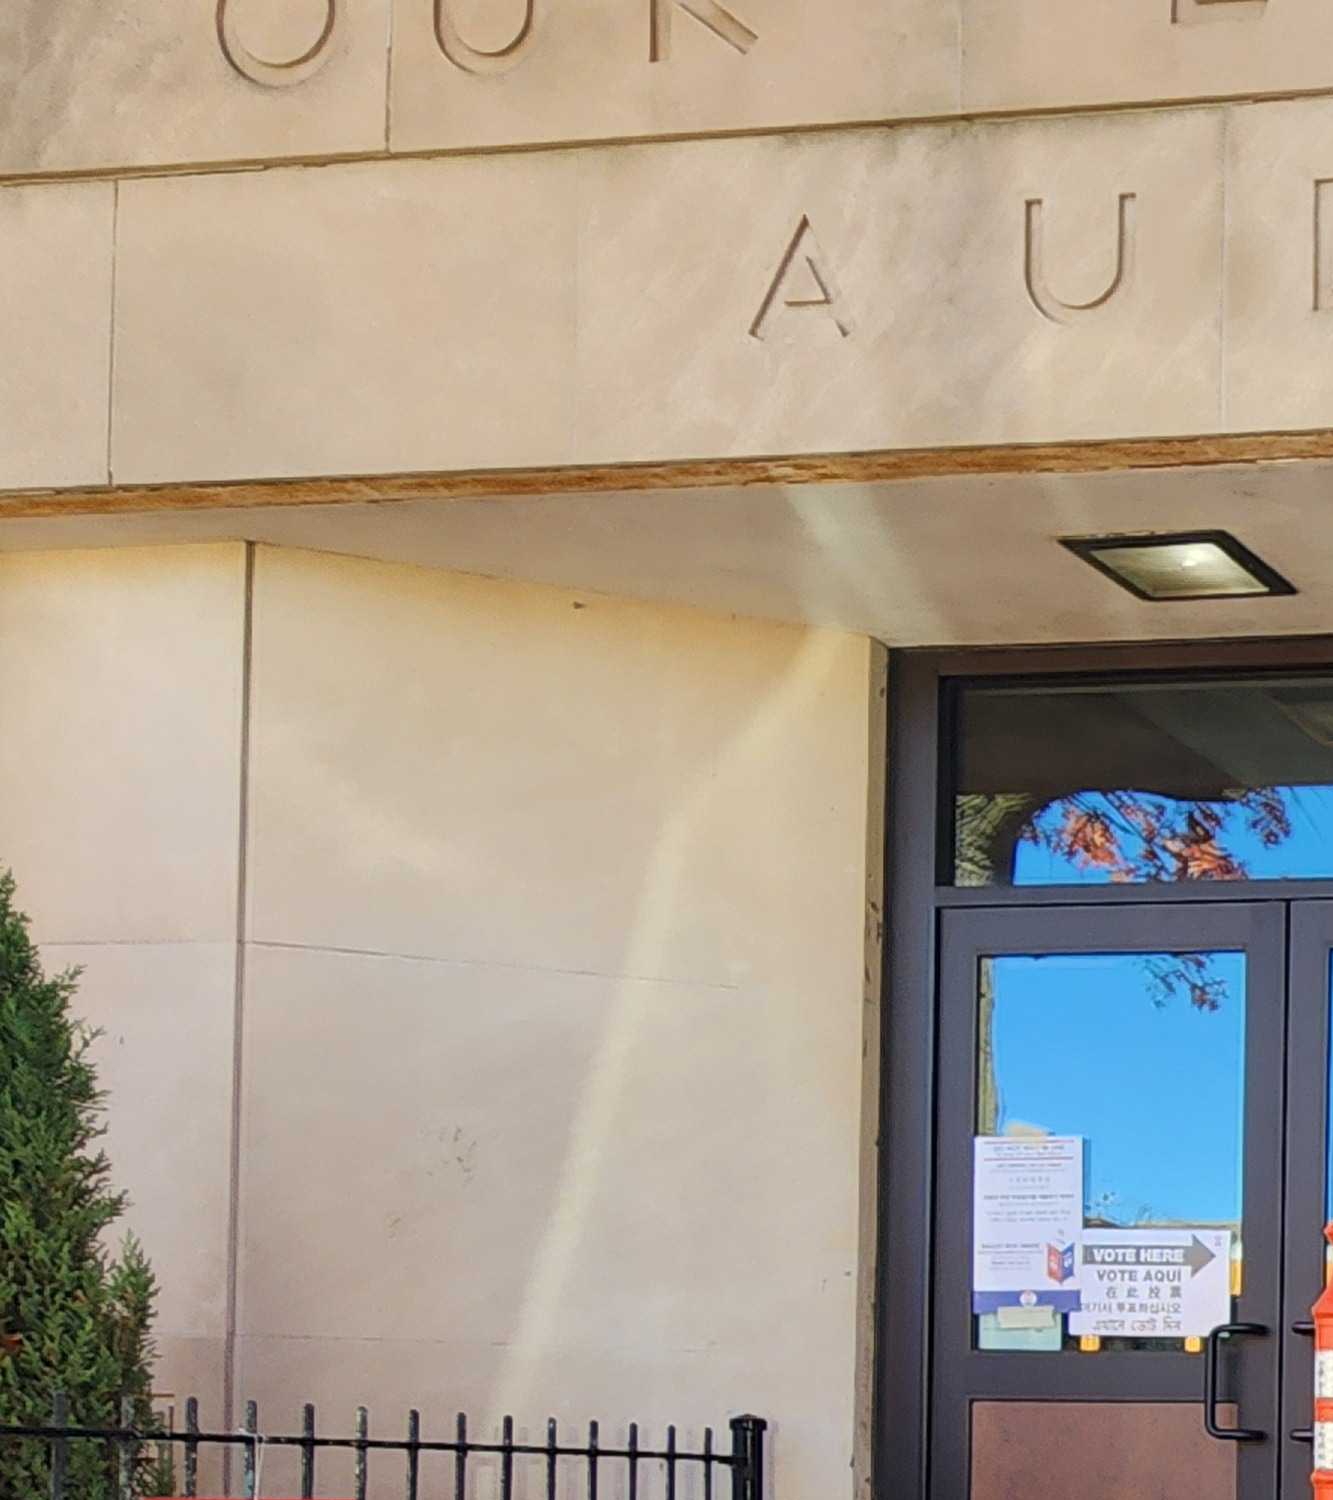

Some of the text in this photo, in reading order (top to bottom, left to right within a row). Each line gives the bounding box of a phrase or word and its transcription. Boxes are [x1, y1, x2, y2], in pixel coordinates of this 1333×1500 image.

[1092, 1247, 1184, 1262] VOTE HERE
[1096, 1270, 1138, 1282] VOTE
